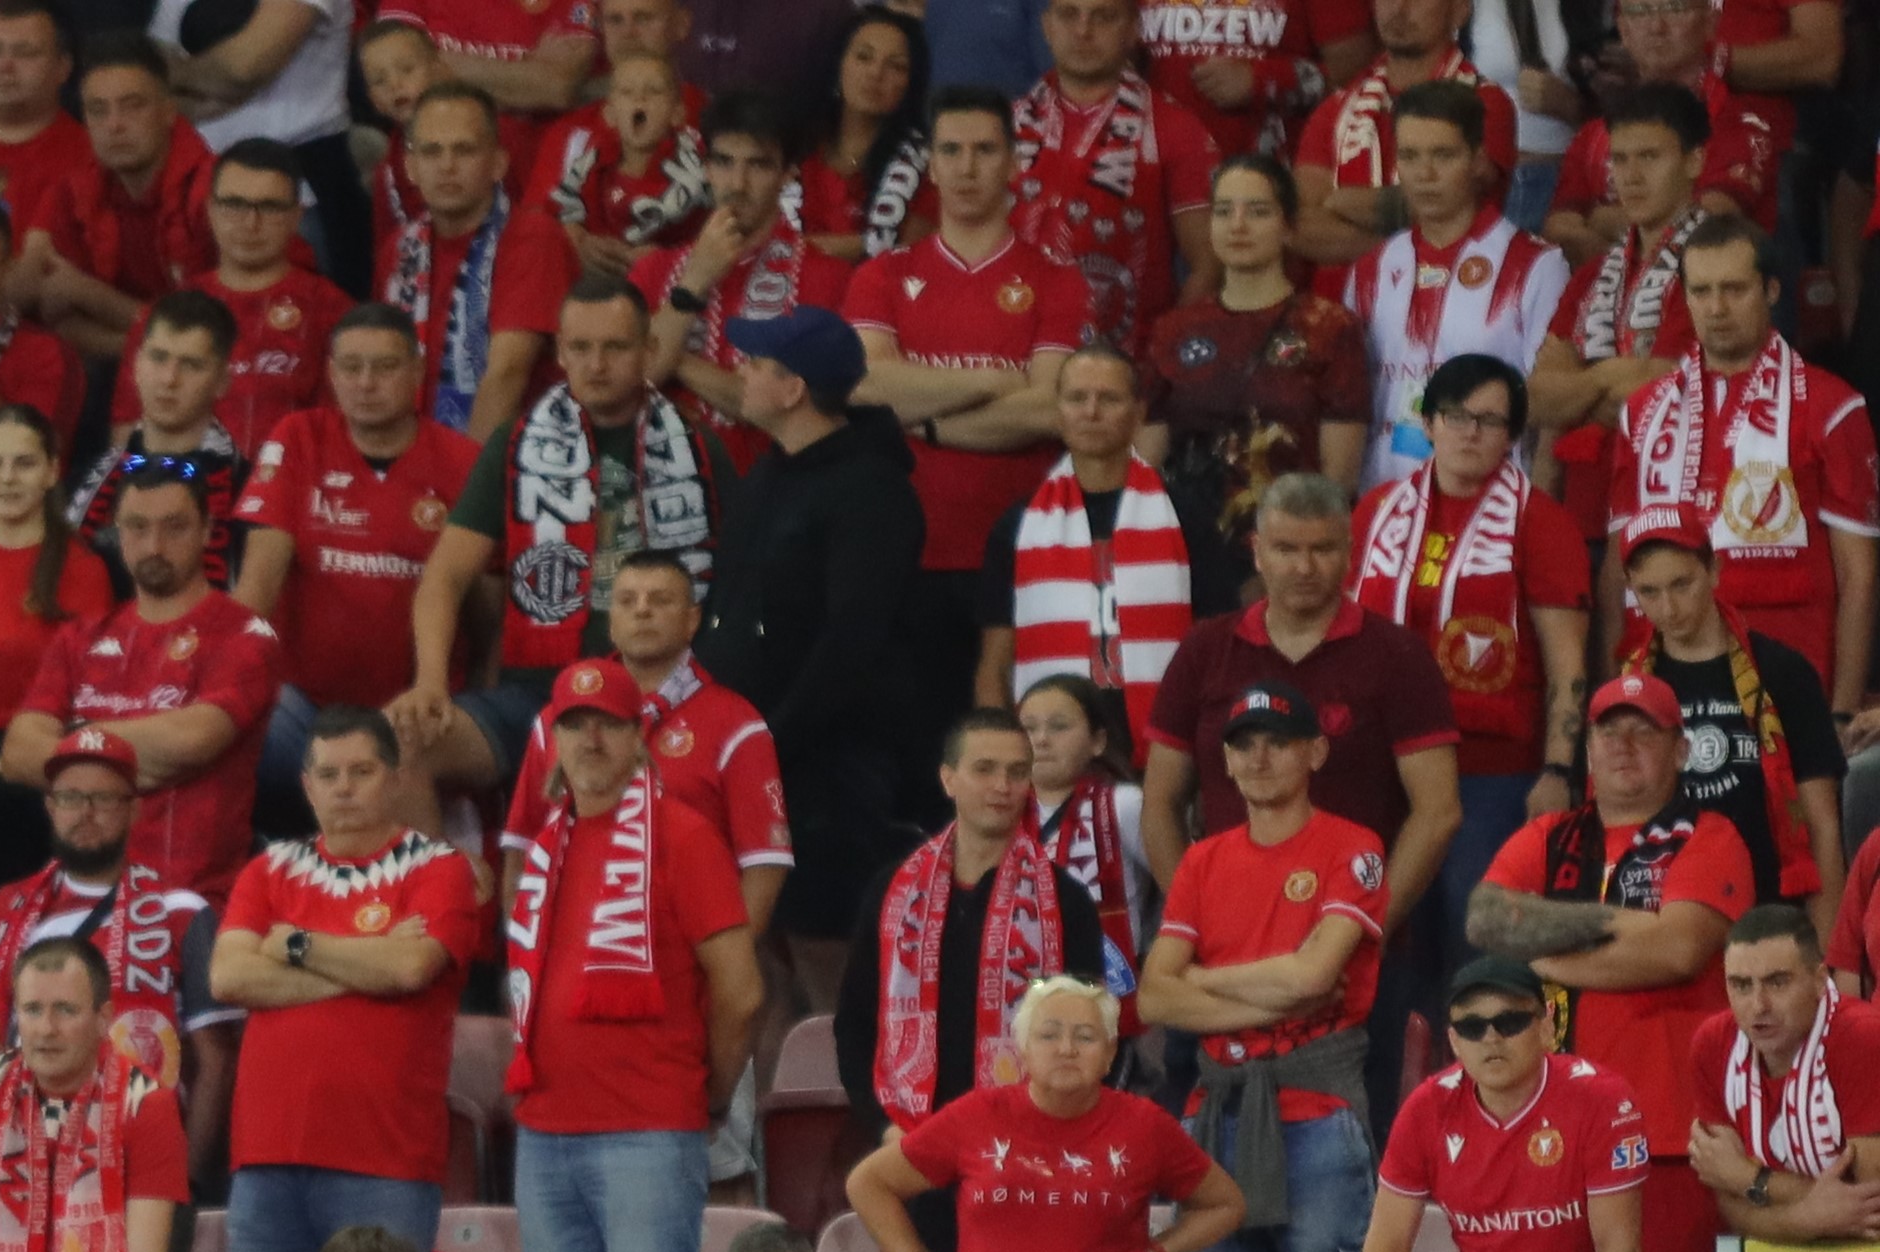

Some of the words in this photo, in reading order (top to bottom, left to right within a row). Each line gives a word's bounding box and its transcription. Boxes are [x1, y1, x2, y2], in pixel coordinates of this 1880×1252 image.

[1137, 5, 1288, 47] WIDZEW
[1611, 1135, 1649, 1171] STS
[1455, 1200, 1582, 1232] PANATTONI
